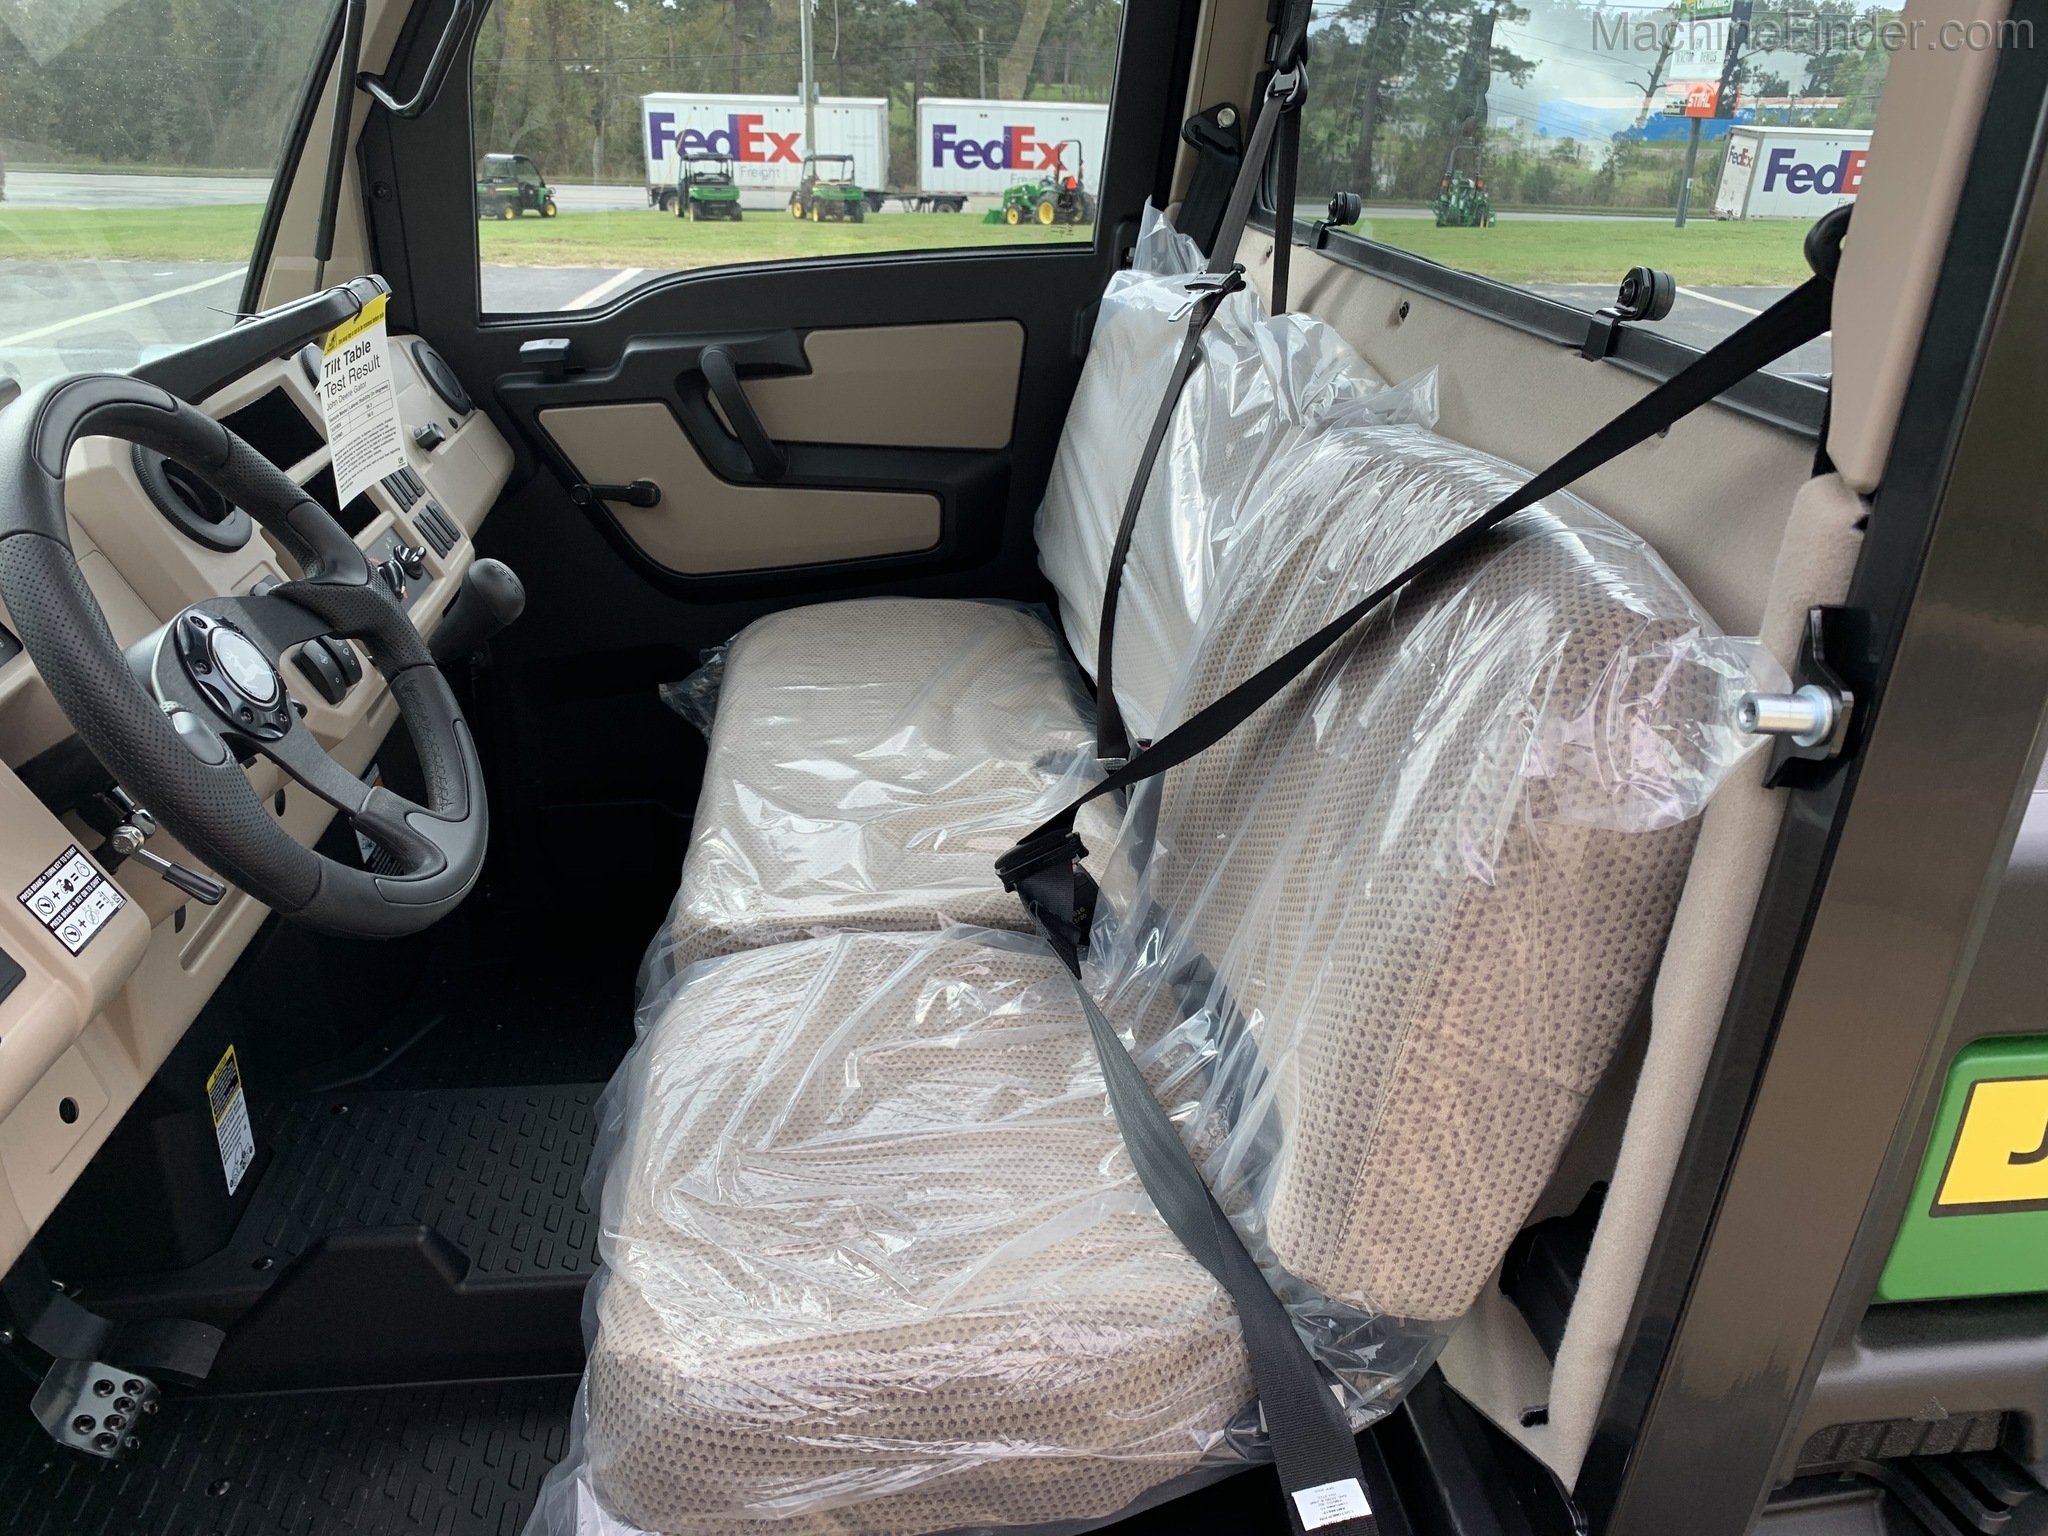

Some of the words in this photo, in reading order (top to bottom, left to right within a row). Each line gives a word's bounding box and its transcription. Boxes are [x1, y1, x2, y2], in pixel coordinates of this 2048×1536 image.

[649, 112, 801, 163] FedEx
[932, 124, 1068, 170] FedEx
[740, 166, 781, 180] Freight
[1728, 145, 1753, 168] FedEx
[324, 357, 340, 378] Tilt
[343, 341, 371, 366] Table
[324, 375, 346, 398] Test
[348, 354, 380, 384] Result
[327, 398, 338, 411] John
[339, 389, 353, 403] Deere
[354, 381, 367, 394] Gator
